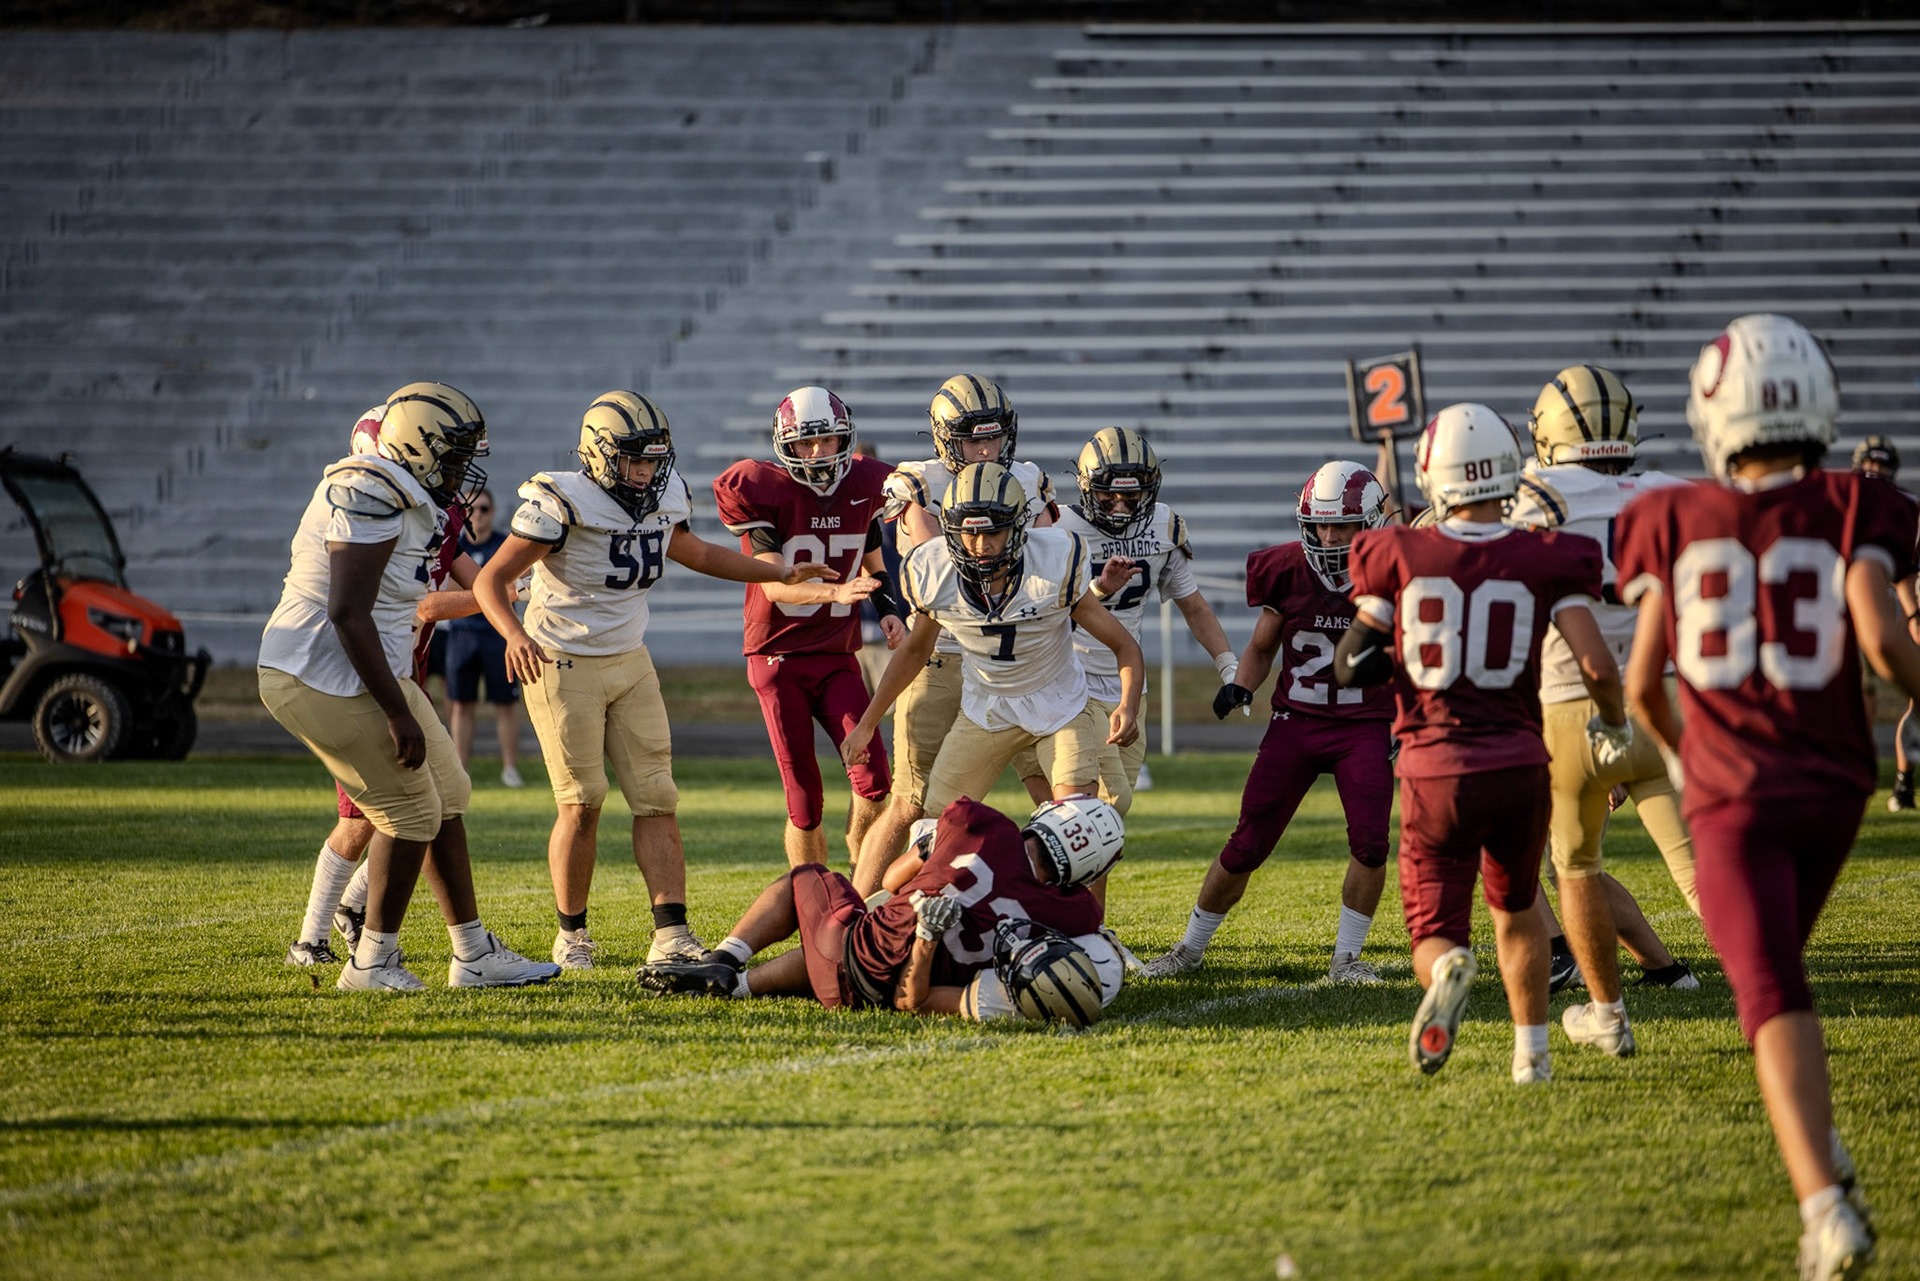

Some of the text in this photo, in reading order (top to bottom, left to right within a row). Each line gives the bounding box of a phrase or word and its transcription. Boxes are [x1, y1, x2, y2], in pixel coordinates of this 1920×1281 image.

[1364, 364, 1409, 426] 2
[1762, 379, 1799, 410] 83
[1581, 444, 1628, 455] Riddell
[1465, 458, 1492, 481] 80
[811, 516, 841, 528] RAMS
[605, 530, 665, 590] 58
[1101, 540, 1161, 559] BERNARD'S
[1314, 615, 1351, 629] RAMS
[1672, 536, 1847, 692] 83
[980, 624, 1017, 661] 7
[1401, 576, 1536, 690] 80
[1047, 834, 1069, 864] schutt
[1063, 823, 1090, 852] 33
